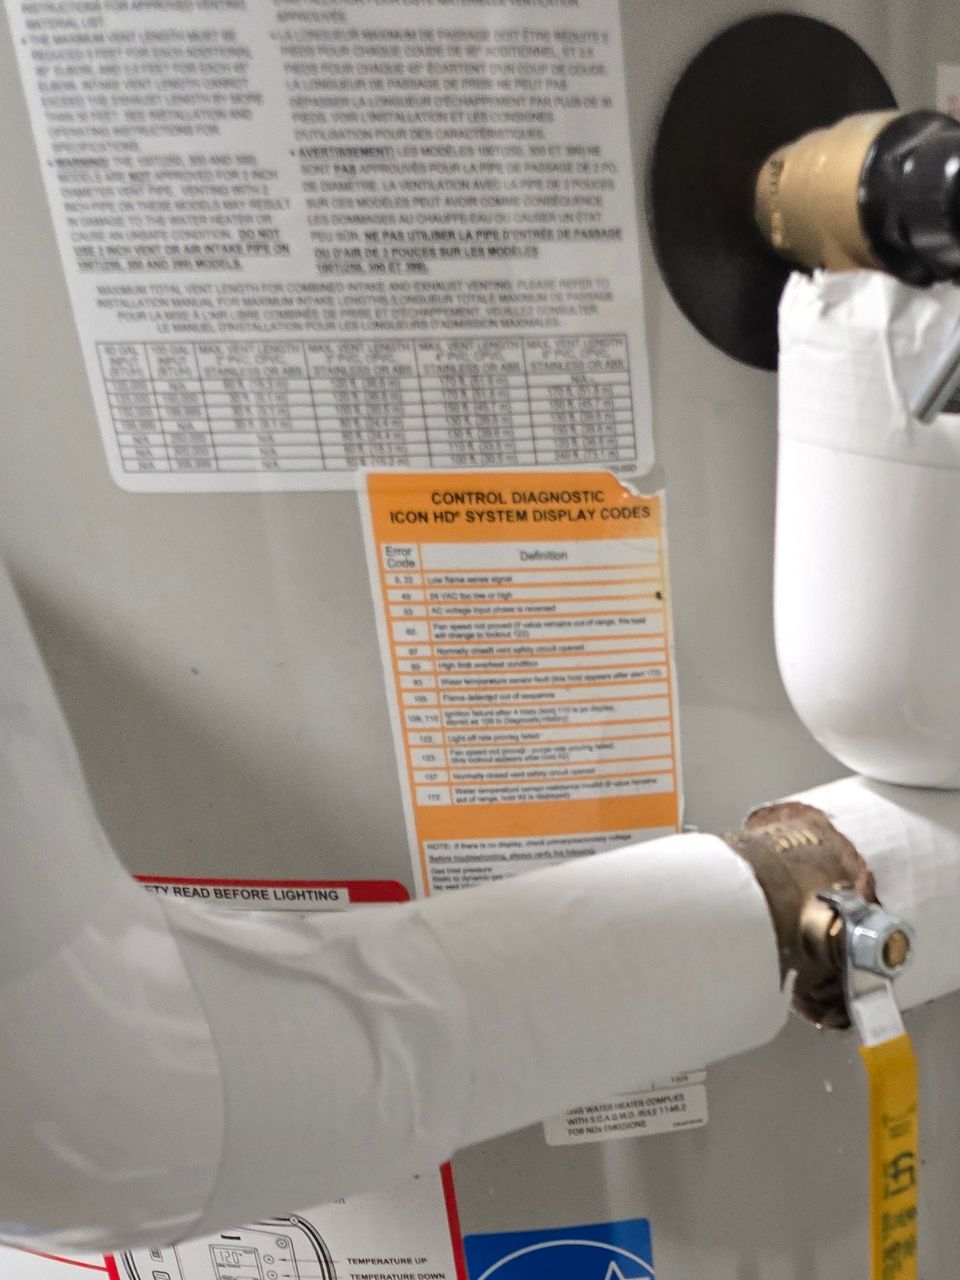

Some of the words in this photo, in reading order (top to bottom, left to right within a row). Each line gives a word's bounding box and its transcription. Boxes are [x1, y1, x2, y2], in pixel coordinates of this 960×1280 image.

[431, 492, 506, 505] CONTROL
[511, 490, 604, 503] DIAGNOSTIC
[389, 511, 428, 523] ICON
[464, 509, 528, 522] SYSTEM
[532, 508, 595, 522] DISPLAY
[599, 506, 650, 519] CODES
[385, 547, 412, 556] Error
[519, 550, 568, 561] Definition
[387, 558, 415, 568] Code
[172, 886, 211, 899] READ
[213, 888, 270, 900] BEFORE
[273, 889, 340, 902] LIGHTING
[346, 1257, 412, 1265] TEMPERATURE
[350, 1273, 415, 1280] TEMPERATURE
[417, 1272, 446, 1280] DOWN
